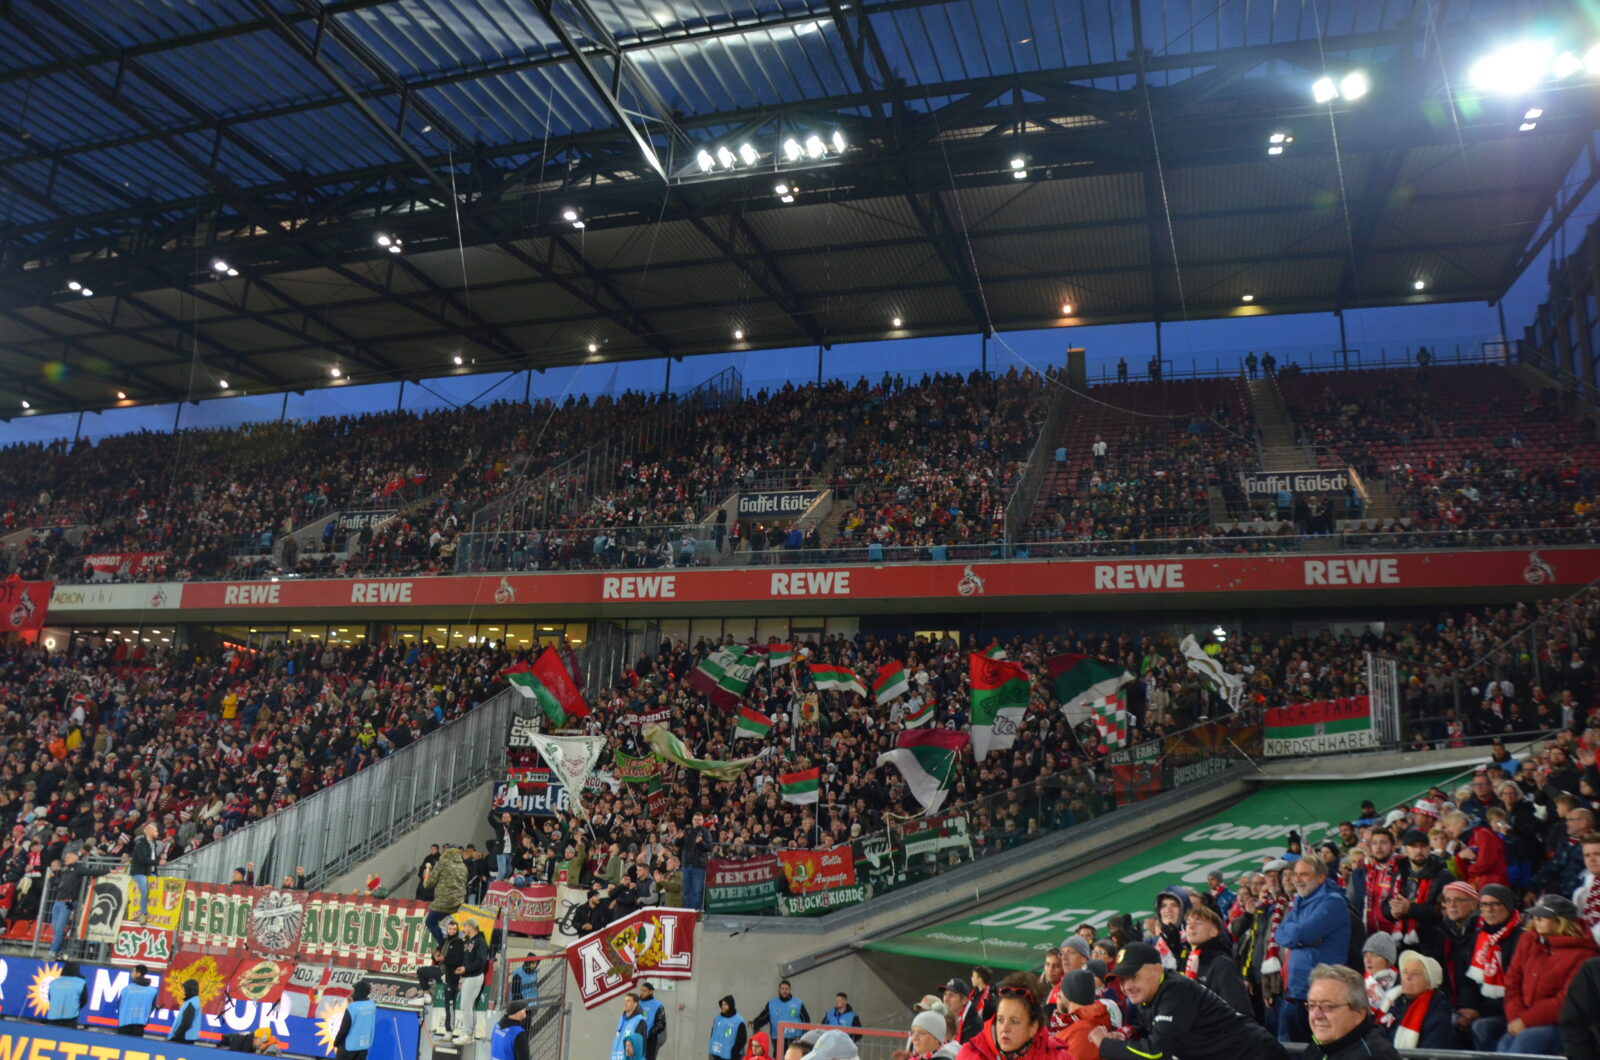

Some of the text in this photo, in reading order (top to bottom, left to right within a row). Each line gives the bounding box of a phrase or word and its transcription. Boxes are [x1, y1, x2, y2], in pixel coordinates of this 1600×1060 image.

[740, 494, 779, 514] Gaffel
[771, 571, 850, 595] REWE
[1095, 563, 1185, 589] REWE
[1304, 559, 1400, 586] REWE
[224, 585, 281, 604] REWE
[351, 583, 413, 603] REWE
[602, 575, 676, 599] REWE
[1324, 700, 1363, 717] FANS
[1266, 731, 1379, 754] NORDSCHWABEN
[715, 867, 773, 884] TEXTIL
[183, 896, 252, 937] LEGIO
[302, 906, 438, 956] AUGUSTA
